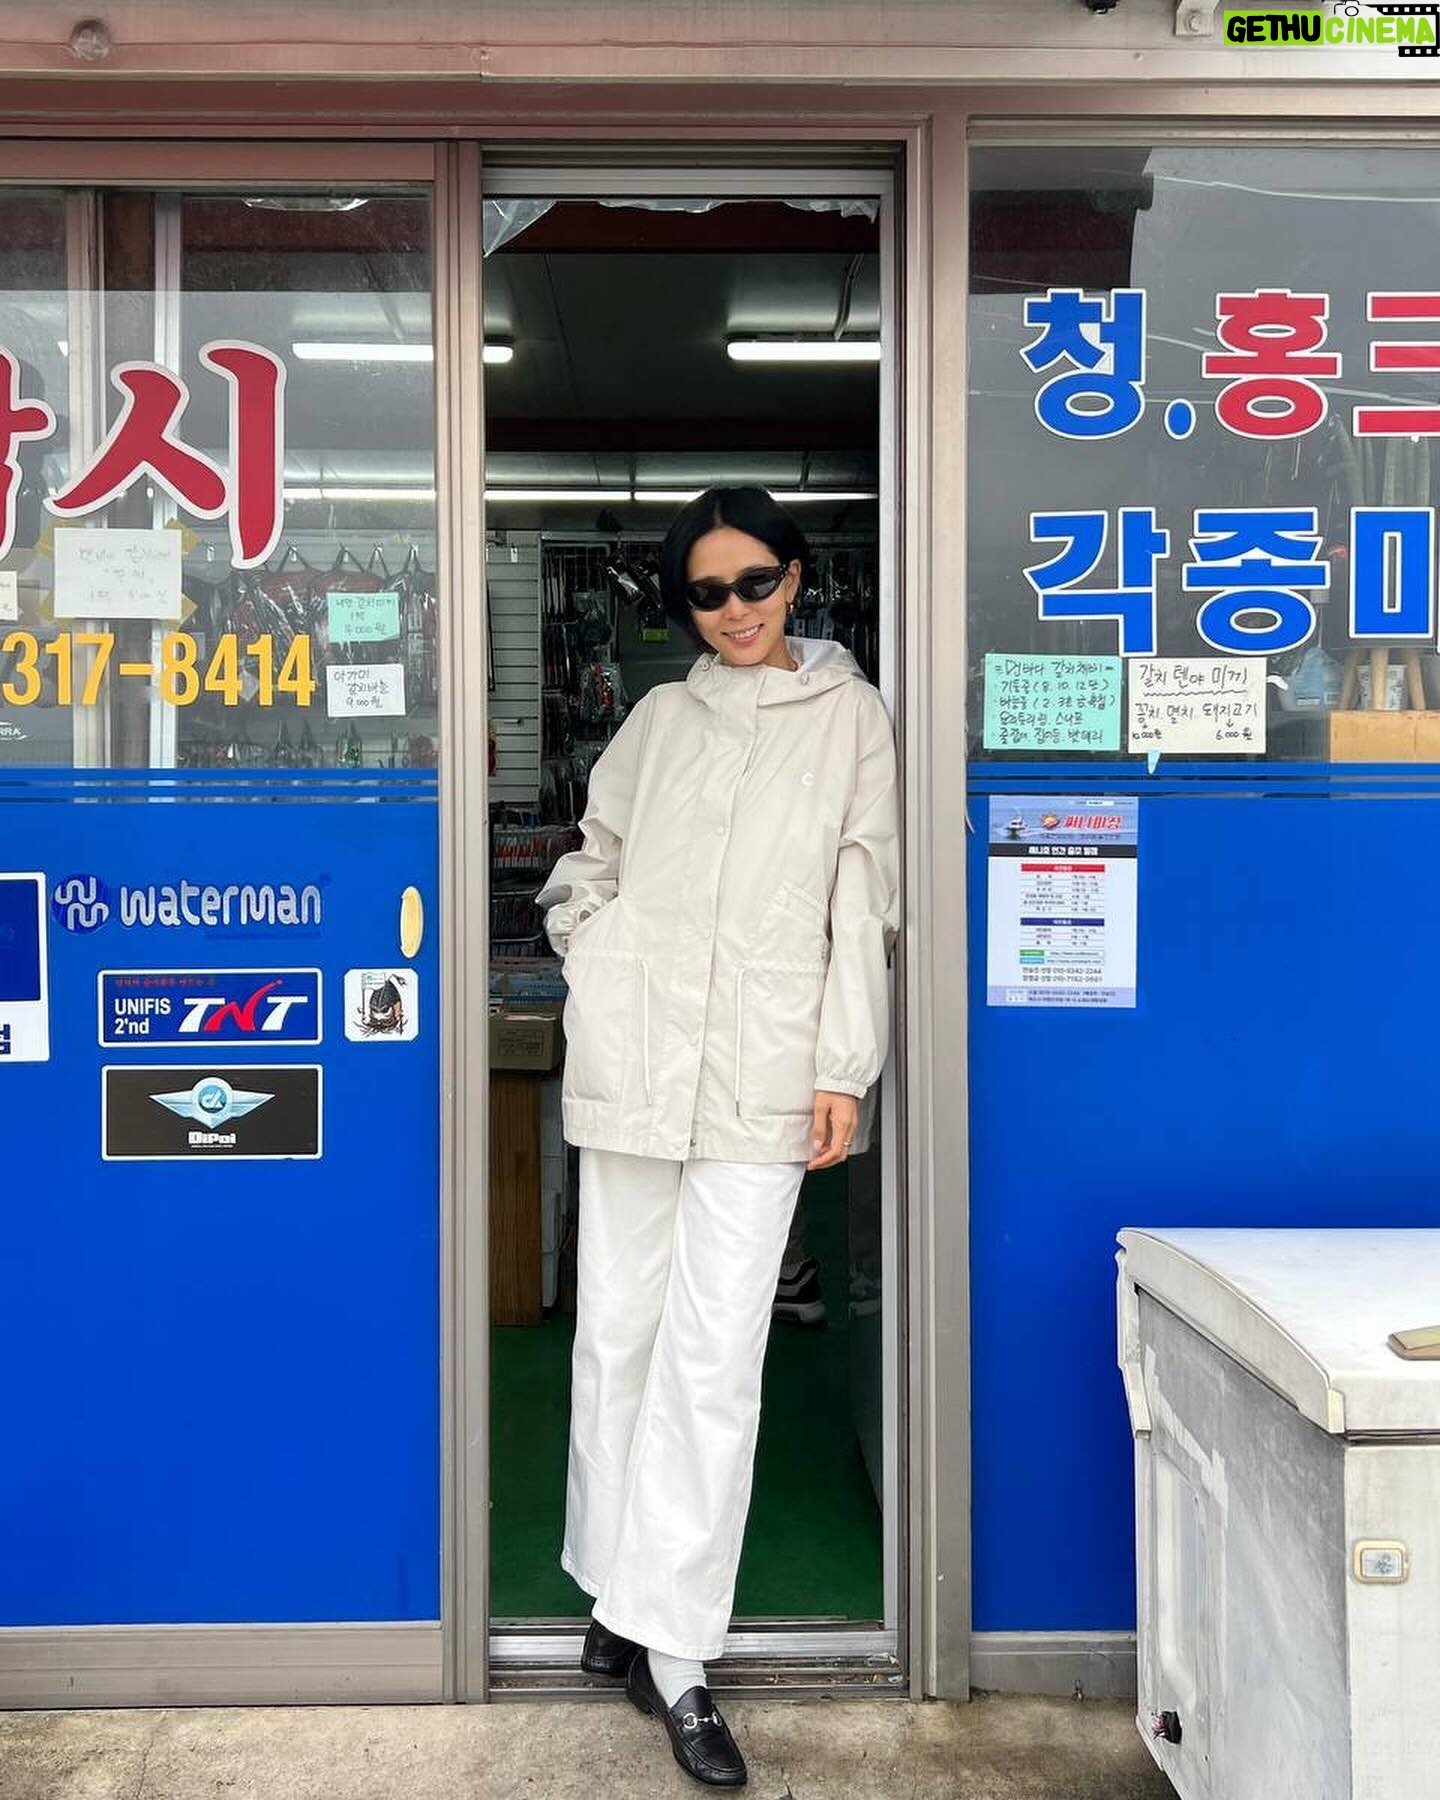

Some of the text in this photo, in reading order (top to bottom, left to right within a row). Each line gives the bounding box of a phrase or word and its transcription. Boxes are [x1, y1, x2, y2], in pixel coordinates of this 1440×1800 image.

[2, 631, 317, 707] 317-8414
[1139, 664, 1168, 689] 갈치
[114, 997, 171, 1015] UNIFIS
[178, 979, 308, 1032] TNT
[114, 1018, 149, 1034] 2'nd
